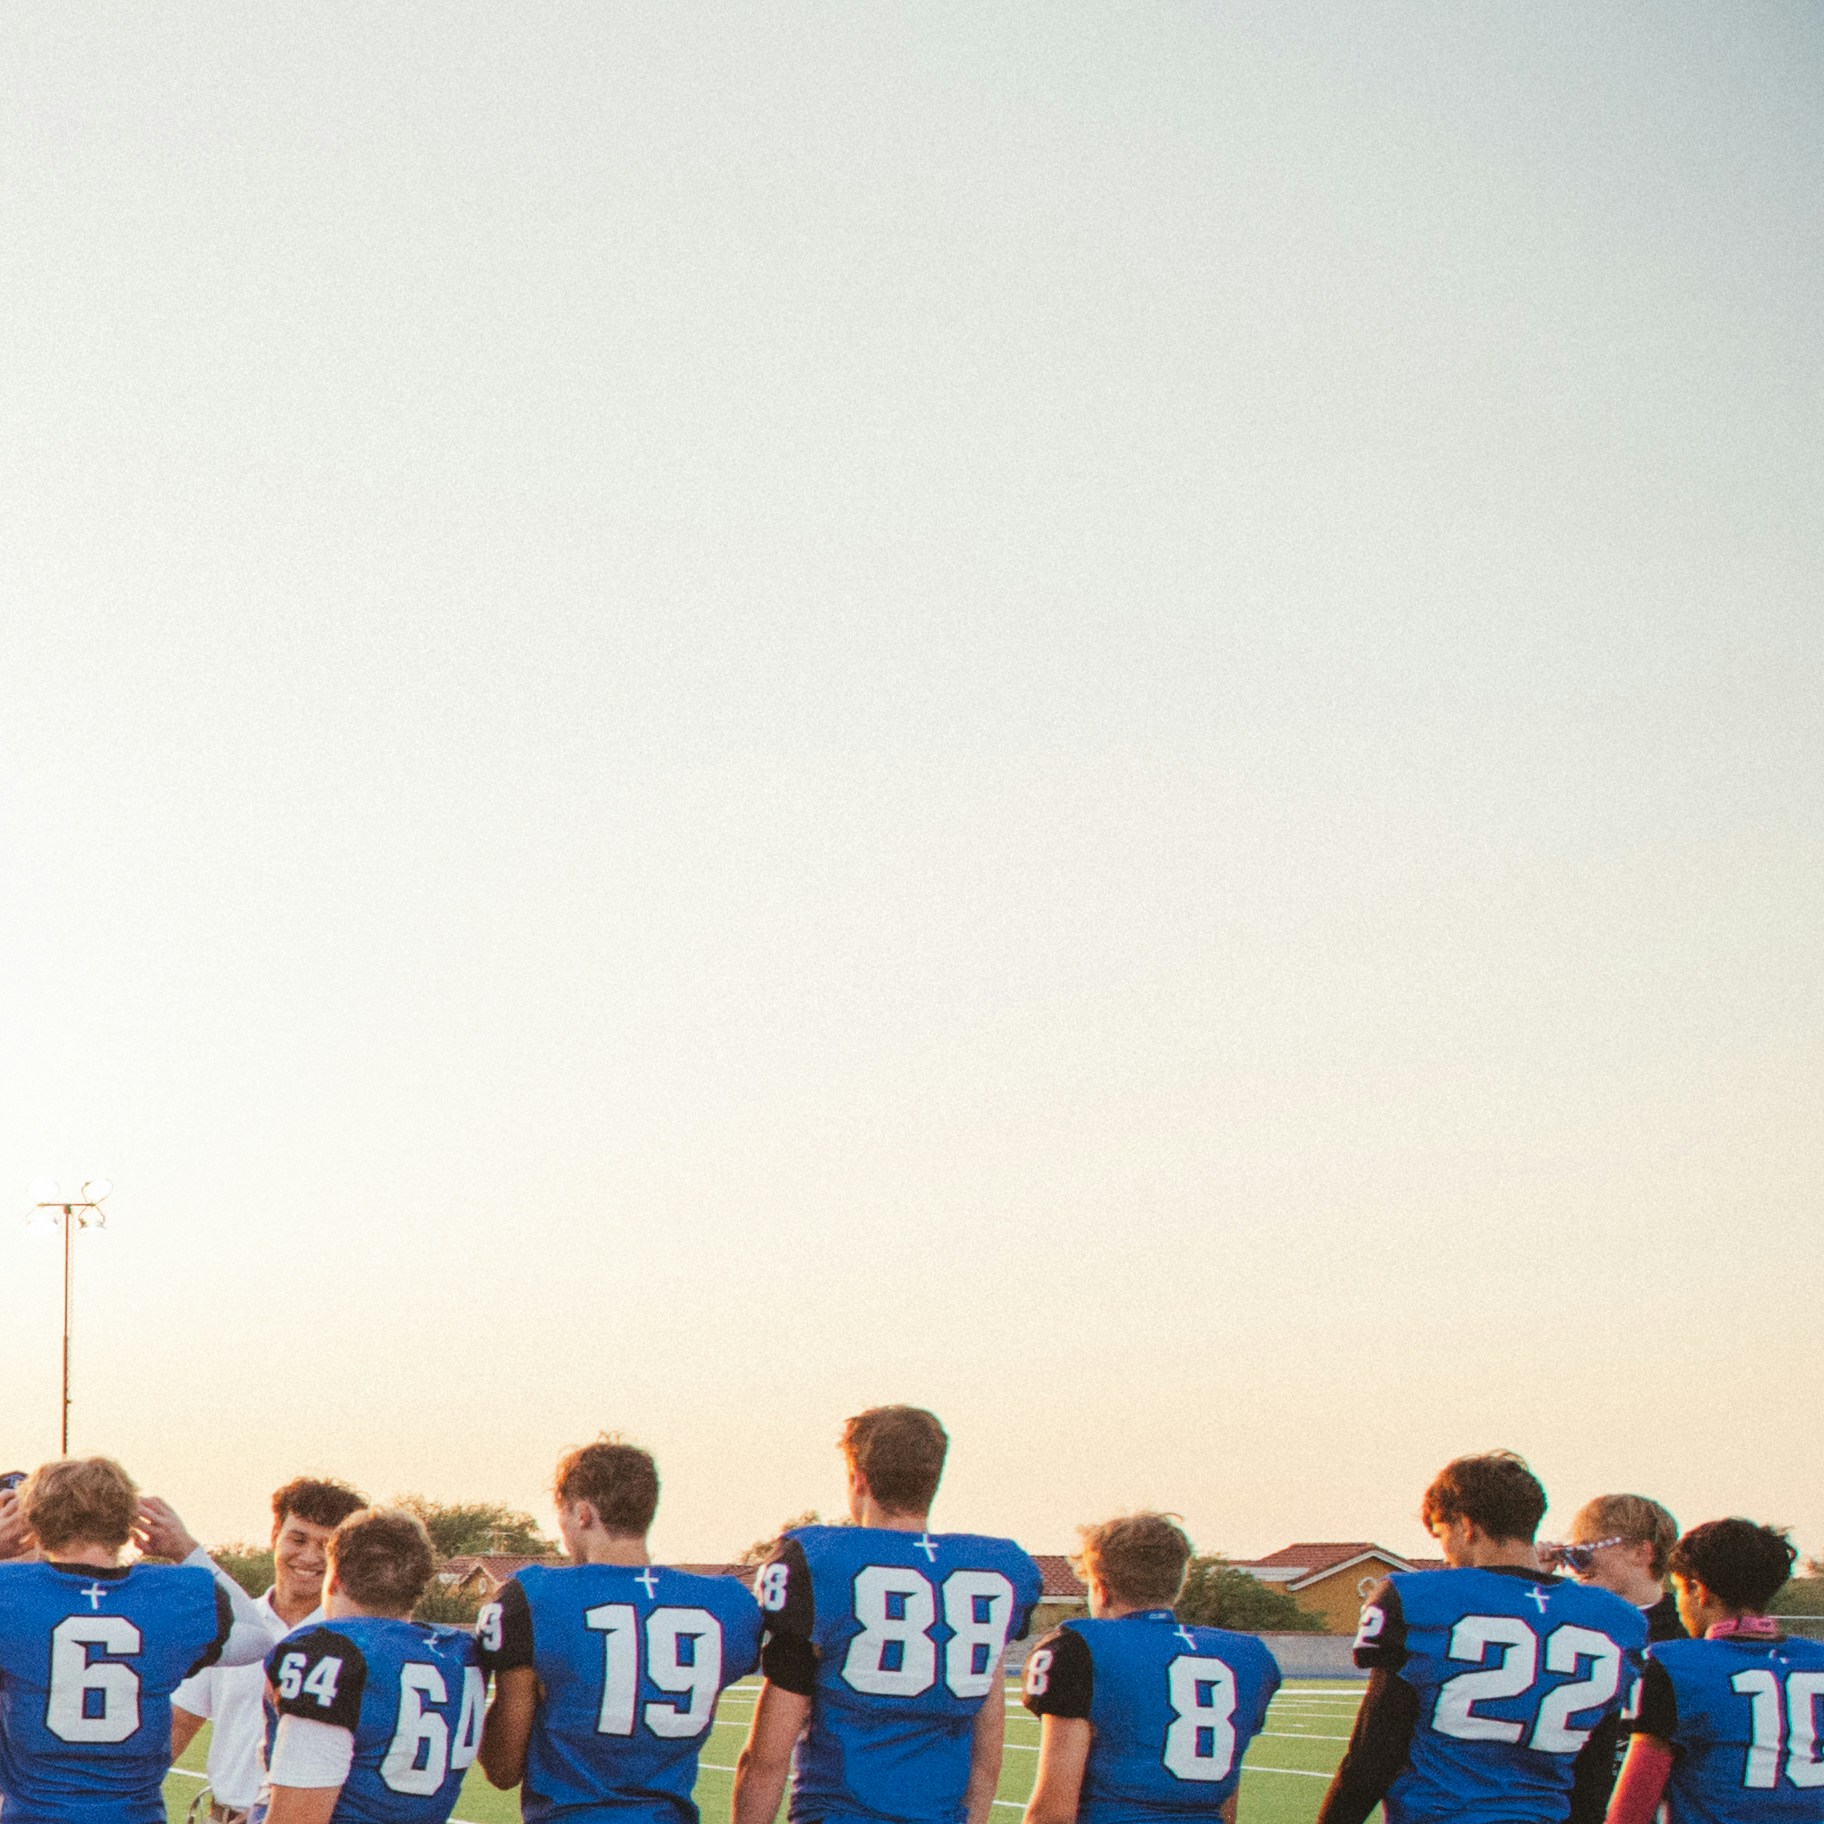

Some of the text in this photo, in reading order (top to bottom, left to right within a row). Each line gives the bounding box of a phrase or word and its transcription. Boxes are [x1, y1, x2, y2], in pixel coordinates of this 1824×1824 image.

[44, 1614, 143, 1745] 6
[276, 1651, 344, 1708] 64
[584, 1603, 723, 1739] 19
[840, 1565, 1015, 1698] 88
[1025, 1649, 1054, 1697] 8
[1430, 1613, 1622, 1753] 22
[378, 1662, 486, 1797] 64
[1162, 1654, 1237, 1783] 8
